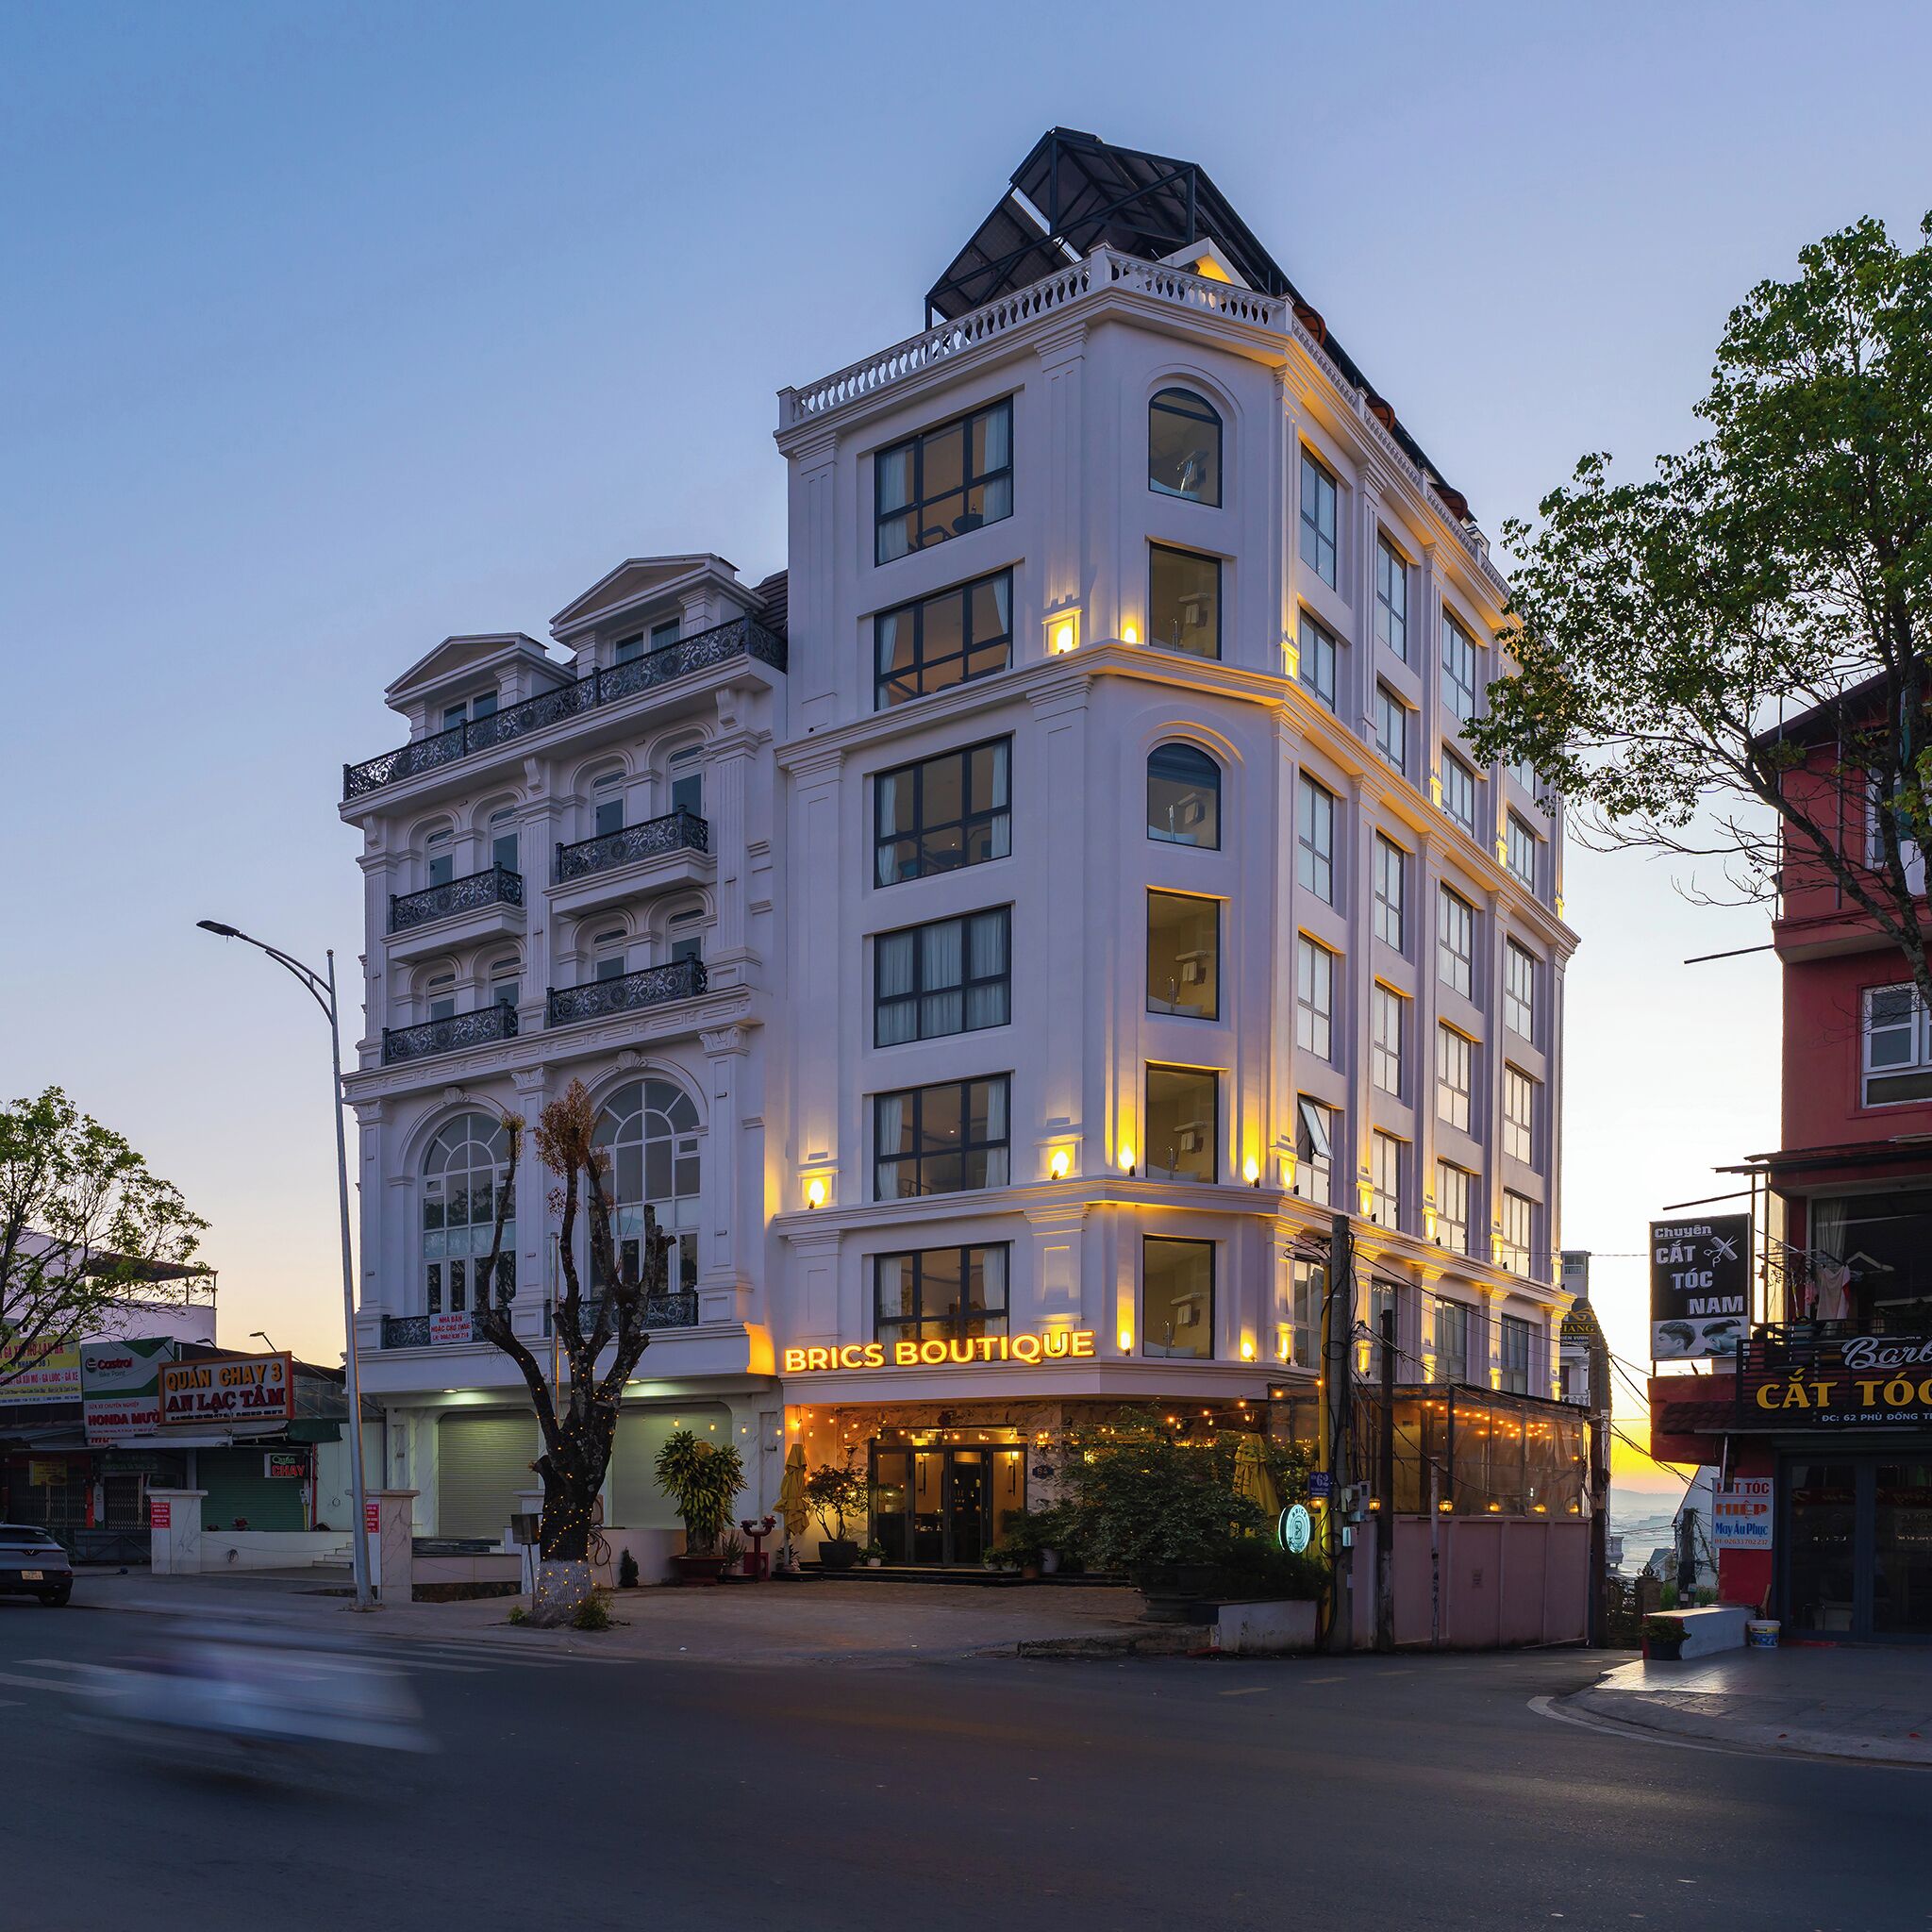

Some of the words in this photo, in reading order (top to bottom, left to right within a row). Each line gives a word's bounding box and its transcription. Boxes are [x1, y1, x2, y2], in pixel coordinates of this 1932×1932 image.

[1655, 1224, 1712, 1238] Chuyên
[1656, 1240, 1696, 1264] CẮT
[1671, 1268, 1713, 1290] TÓC
[1688, 1295, 1743, 1315] NAM
[785, 1342, 884, 1373] BRICS
[895, 1329, 1096, 1364] BOUTIQUE
[97, 1358, 133, 1371] Castrol
[166, 1366, 211, 1391] QUÁN
[219, 1364, 267, 1387] CHAY
[271, 1362, 282, 1382] 3
[166, 1394, 192, 1413] AN
[196, 1391, 237, 1413] LẠC
[240, 1384, 285, 1407] TÂM
[1756, 1368, 1839, 1409] CẮT
[88, 1413, 129, 1426] HONDA
[131, 1408, 159, 1424] MƯỜ
[272, 1465, 306, 1476] CHAY
[1316, 1474, 1329, 1487] 62
[1745, 1480, 1770, 1494] TÓC
[1716, 1500, 1769, 1520] HIỆP
[1715, 1523, 1732, 1537] May
[1733, 1520, 1745, 1535] Âu
[1746, 1523, 1769, 1537] Phục
